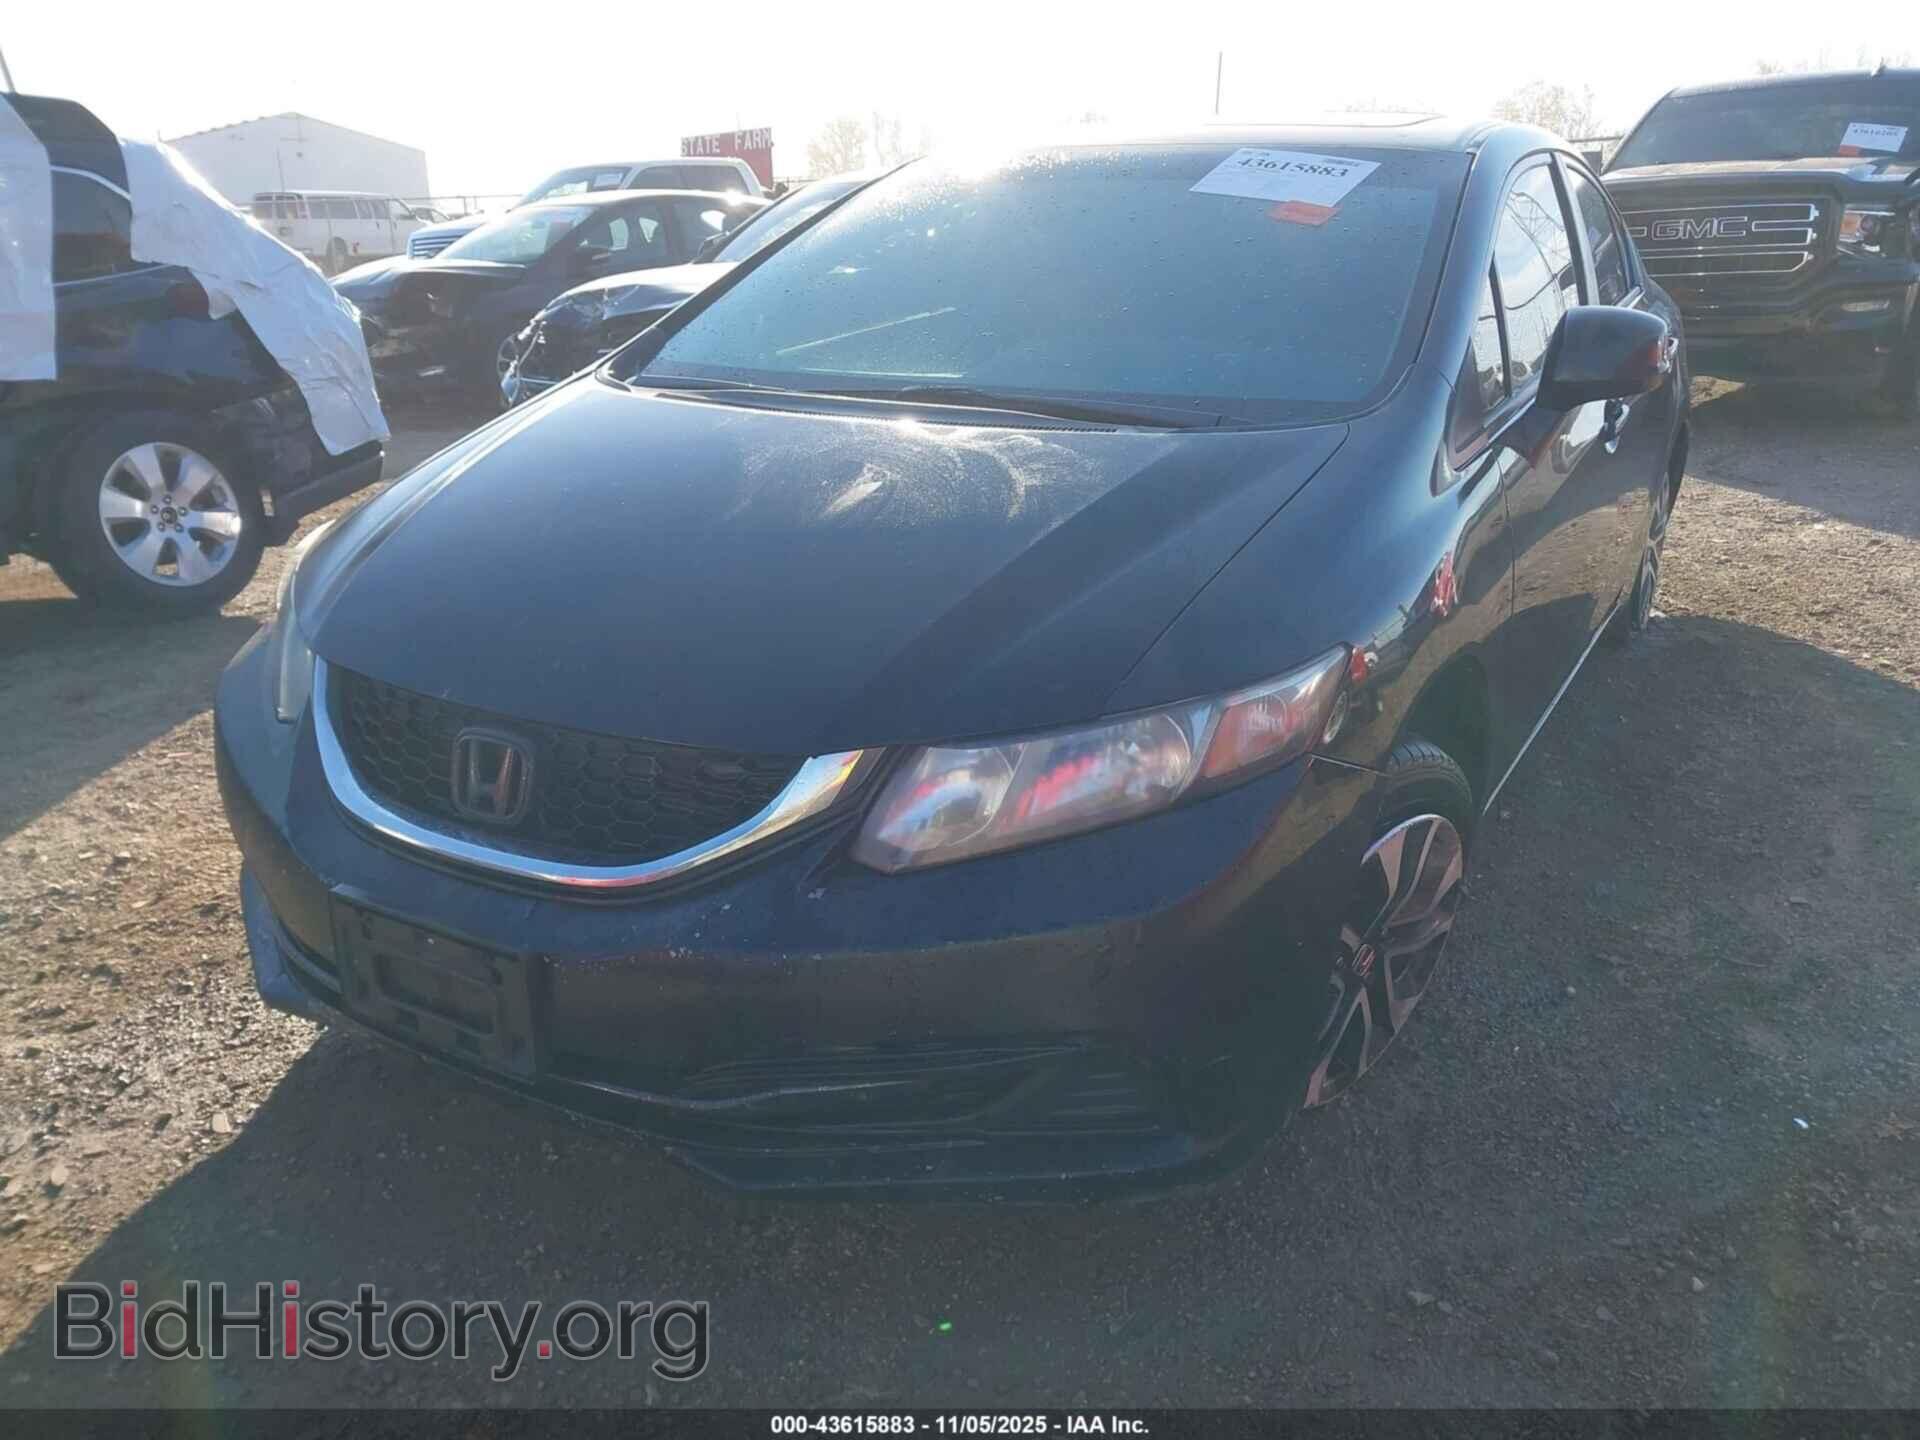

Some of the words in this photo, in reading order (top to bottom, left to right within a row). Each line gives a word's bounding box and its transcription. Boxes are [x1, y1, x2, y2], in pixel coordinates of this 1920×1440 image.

[680, 135, 720, 156] STATE
[734, 127, 773, 151] FARM
[1237, 158, 1349, 177] 43615883
[1652, 216, 1749, 241] GMC
